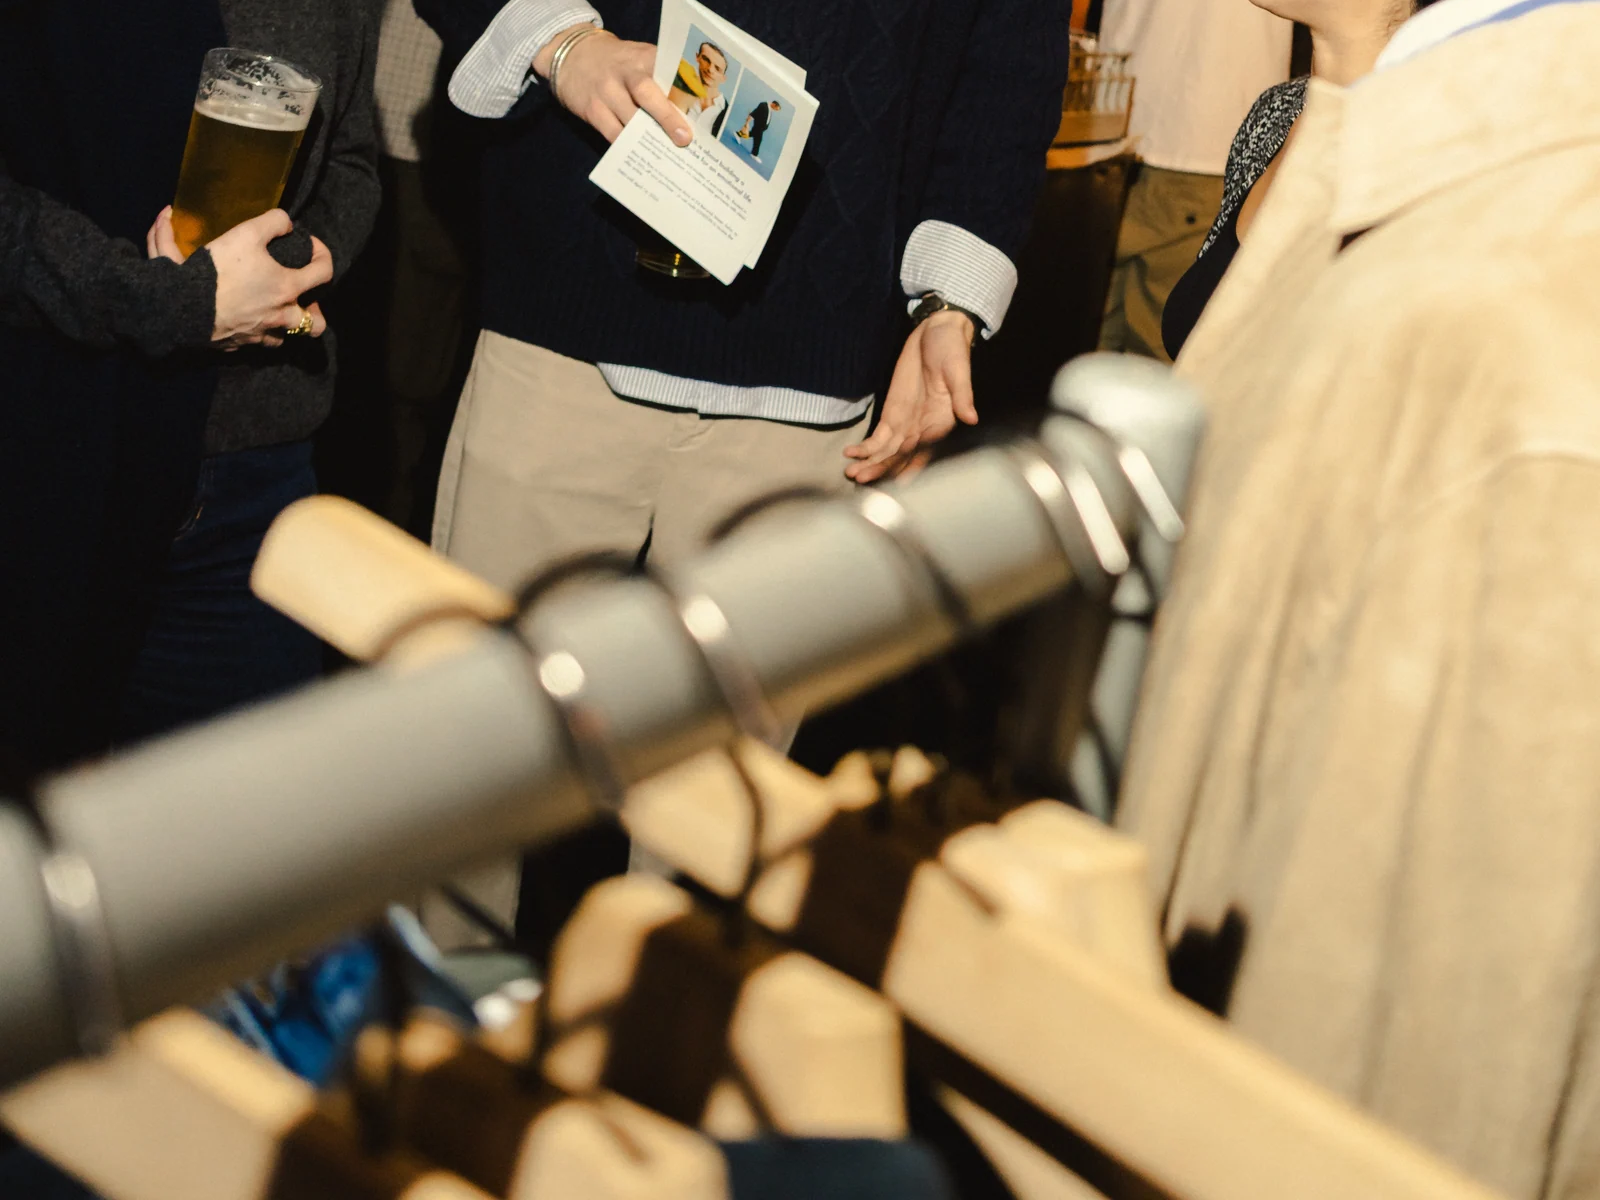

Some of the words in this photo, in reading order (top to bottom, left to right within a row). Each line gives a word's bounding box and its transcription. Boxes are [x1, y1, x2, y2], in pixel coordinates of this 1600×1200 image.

[702, 147, 720, 163] about
[716, 160, 743, 182] building
[714, 171, 744, 195] emotional
